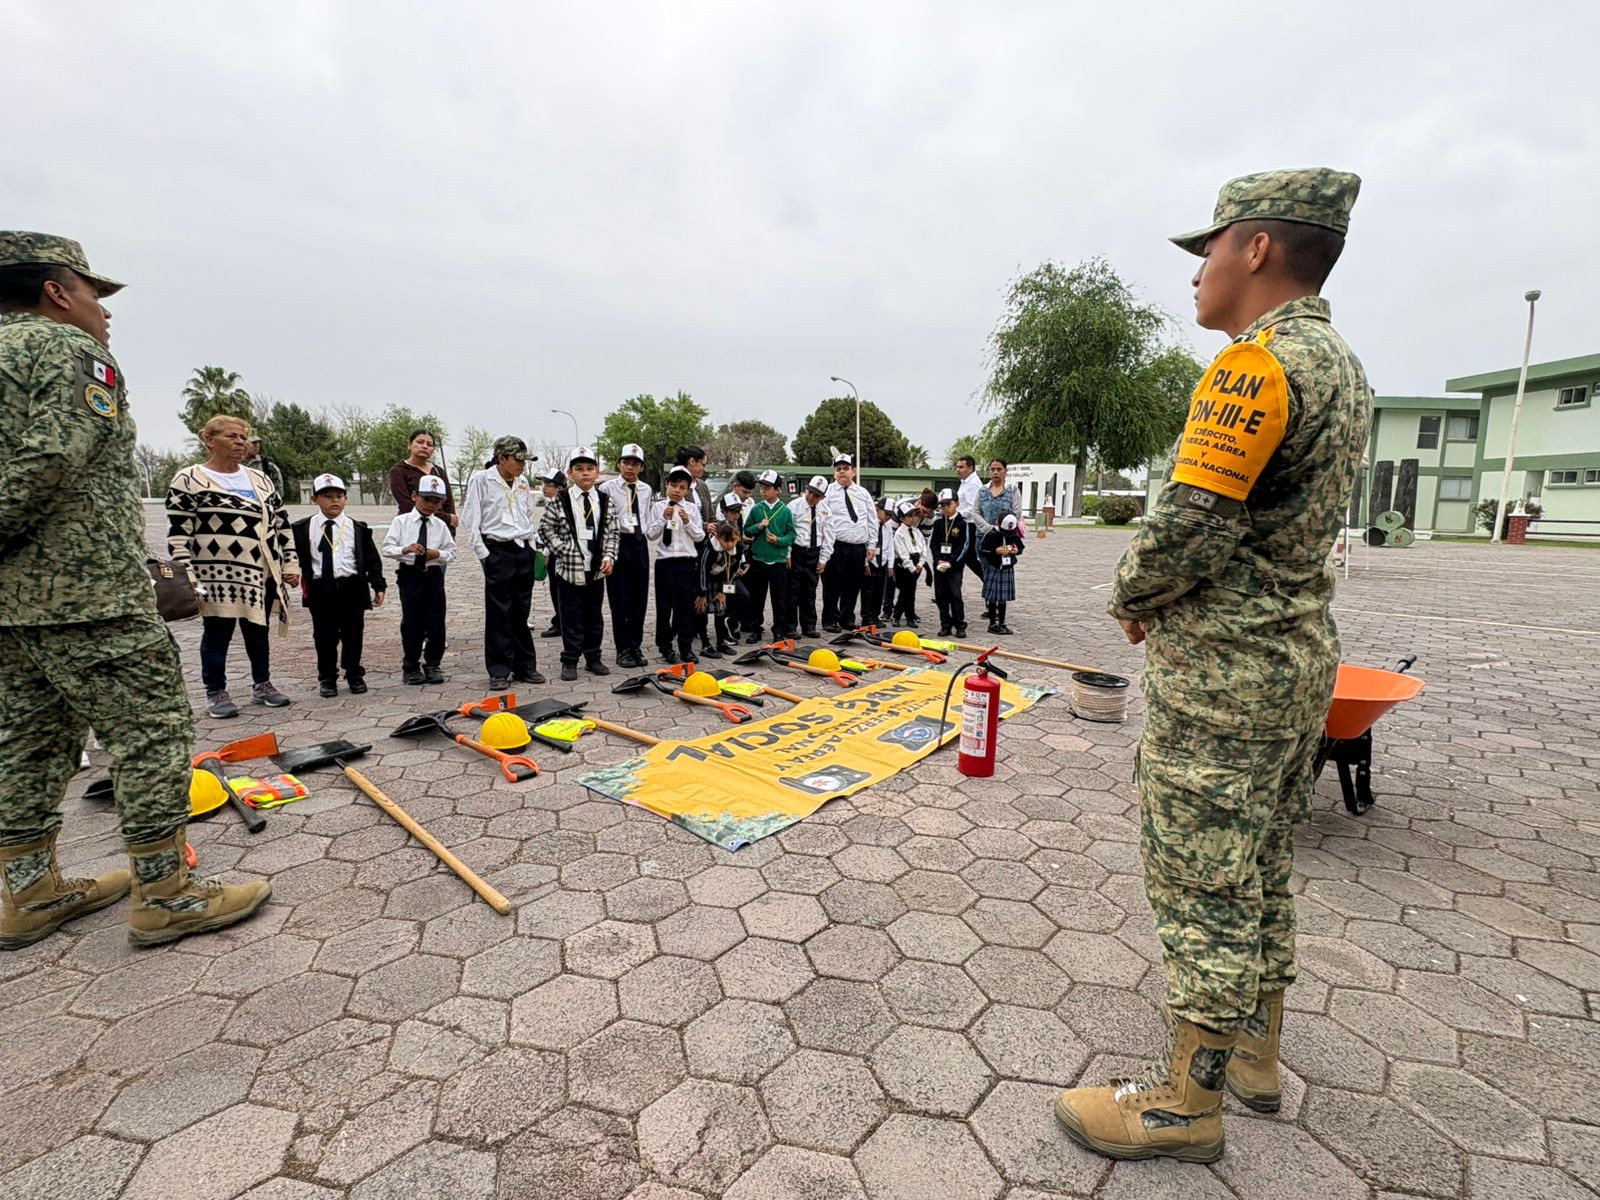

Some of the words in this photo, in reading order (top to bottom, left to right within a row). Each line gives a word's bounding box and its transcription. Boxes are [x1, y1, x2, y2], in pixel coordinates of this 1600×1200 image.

[1210, 369, 1265, 400] PLAN
[1191, 400, 1266, 436] DN-III-E
[1212, 442, 1246, 458] AÉREA
[1200, 461, 1250, 483] NACIONAL
[666, 712, 833, 761] SOCIAL
[787, 735, 842, 764] AÉREA
[773, 763, 791, 771] Y
